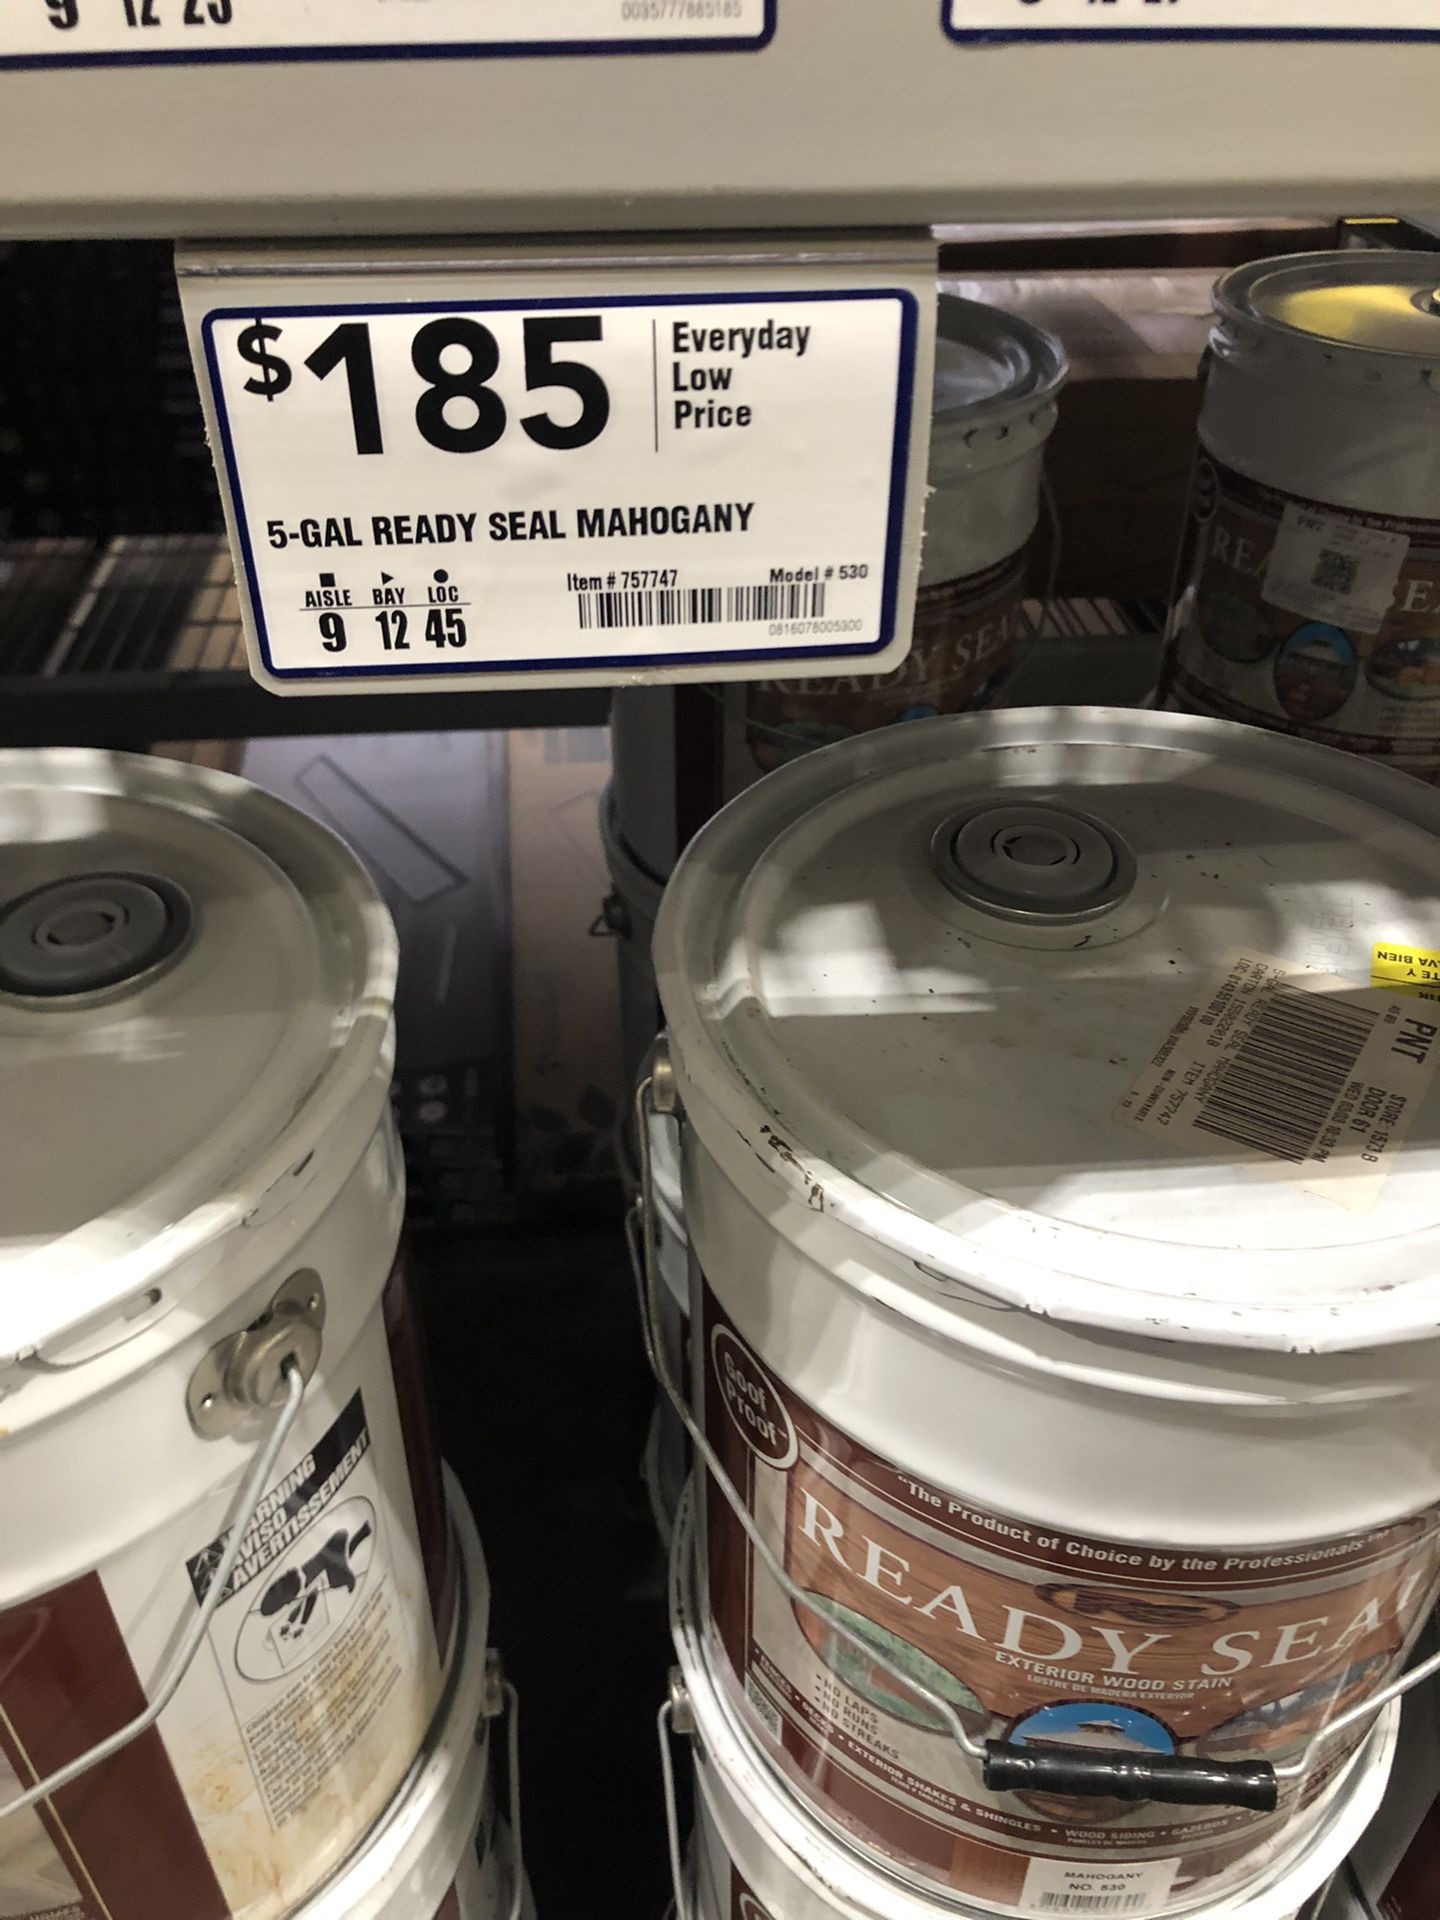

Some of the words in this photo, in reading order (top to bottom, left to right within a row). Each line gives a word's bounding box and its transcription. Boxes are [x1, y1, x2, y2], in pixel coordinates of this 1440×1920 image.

[236, 315, 611, 456] $185
[672, 320, 811, 357] Everyday
[672, 361, 733, 393] Low
[674, 400, 752, 429] Price
[267, 517, 362, 549] 5-GAL
[372, 513, 476, 545] READY
[489, 510, 567, 542] SEAL
[576, 502, 756, 538] MAHOGANY
[567, 572, 603, 592] Item
[606, 570, 617, 588] #
[620, 568, 678, 588] 757747
[769, 567, 820, 583] Model
[824, 565, 835, 580] #
[839, 563, 869, 580] 530
[304, 587, 353, 607] AISLE
[372, 585, 406, 606] BAY
[428, 584, 460, 604] LOC
[320, 612, 348, 654] 9
[374, 611, 410, 651] 12
[425, 608, 468, 649] 45
[767, 619, 864, 637] 0816078005300
[1377, 951, 1412, 964] BIEN
[1406, 968, 1416, 977] Y
[1236, 962, 1270, 995] CARTON
[1389, 1017, 1437, 1064] PNT
[1179, 1060, 1207, 1086] ITEM
[1152, 1088, 1189, 1125] 757747
[1357, 1086, 1386, 1119] DOOR
[1349, 1117, 1370, 1133] 61
[1364, 1128, 1389, 1155] 1573
[1310, 1146, 1330, 1163] PM
[724, 1352, 767, 1412] Goof
[230, 1432, 369, 1591] AVERTISSEMENT
[948, 1501, 1031, 1543] Product
[1036, 1535, 1060, 1551] of
[1065, 1541, 1143, 1566] Choice
[1148, 1554, 1175, 1571] by
[1181, 1558, 1217, 1571] the
[799, 1488, 1173, 1675] READY
[995, 1651, 1095, 1684] EXTERIOR
[1103, 1675, 1165, 1691] WOOD
[1173, 1677, 1234, 1690] STAIN
[1027, 1674, 1068, 1690] LUSTRE
[1071, 1682, 1087, 1692] DE
[1090, 1686, 1138, 1699] MADERA
[823, 1690, 839, 1709] NO
[844, 1707, 878, 1735] RUNS
[824, 1678, 841, 1698] NO
[845, 1690, 878, 1724] LAPS
[822, 1701, 839, 1720] NO
[843, 1718, 899, 1760] STREAKS
[848, 1741, 904, 1780] EXTERIOR
[907, 1777, 957, 1806] SHAKES
[960, 1803, 971, 1812] &
[976, 1807, 1042, 1833] SHINGLES
[1065, 1829, 1106, 1839] WOOD
[1111, 1830, 1155, 1840] SIDING
[1064, 1872, 1144, 1880] MAHOGANY
